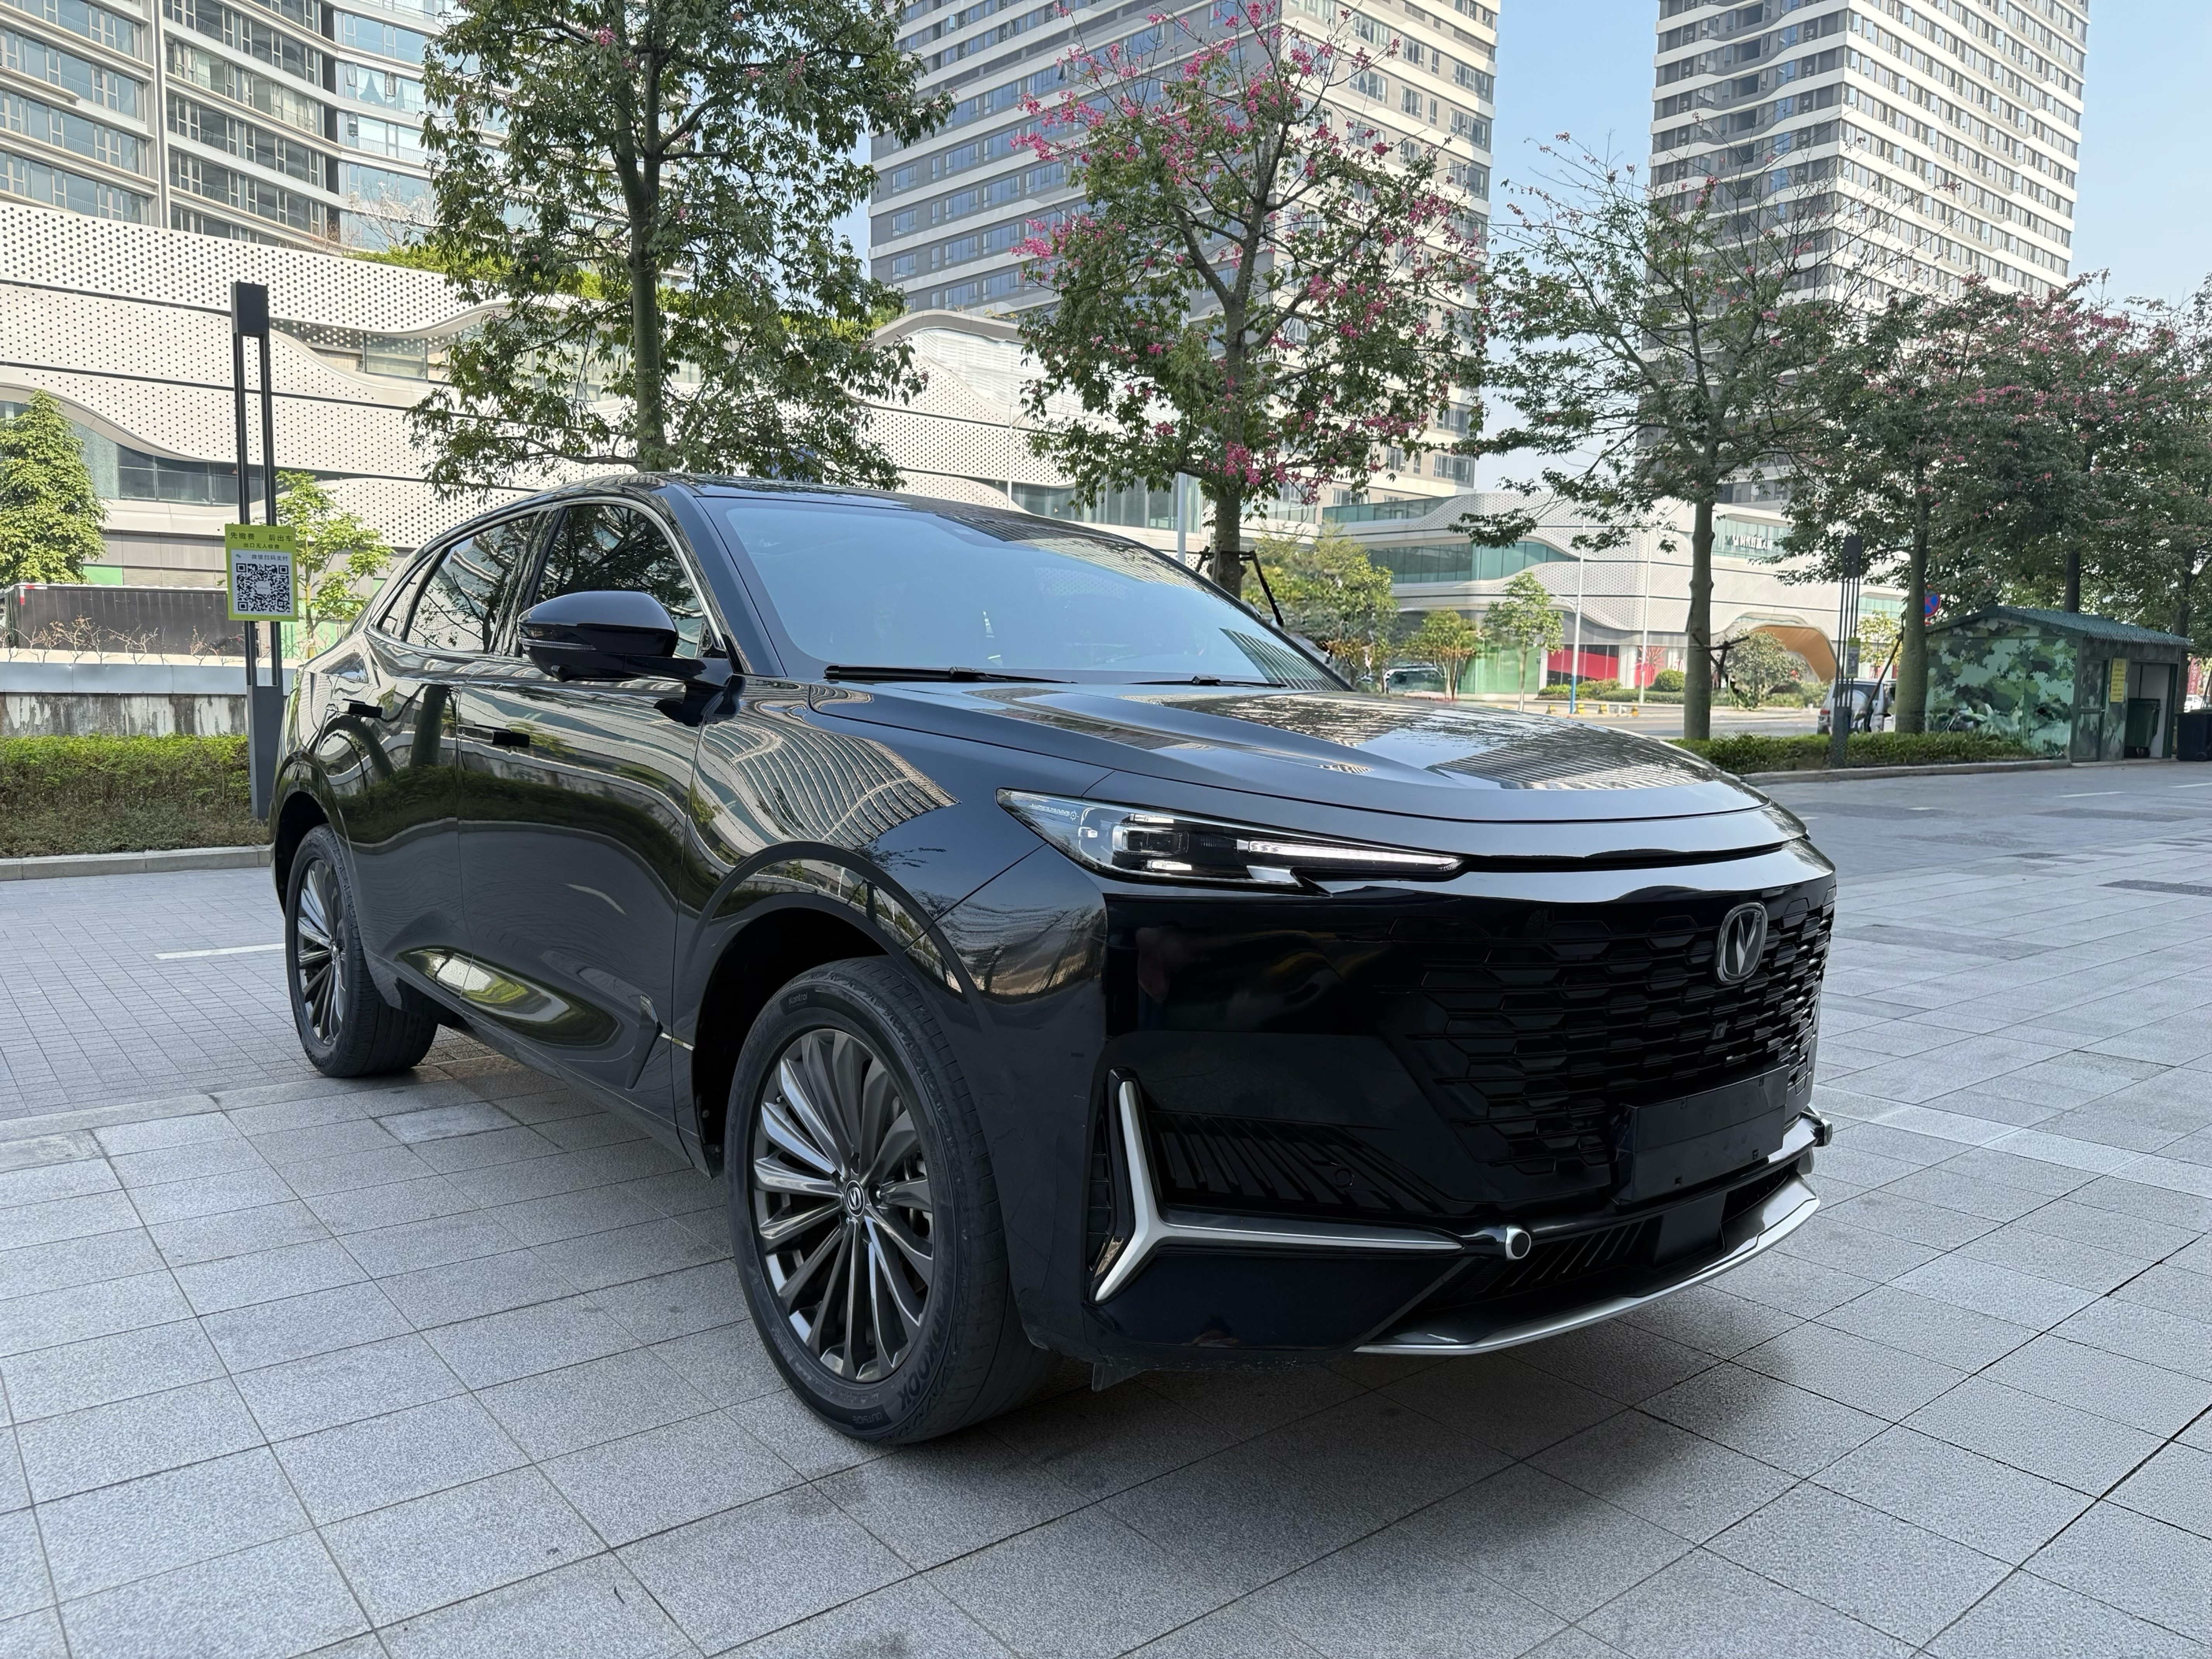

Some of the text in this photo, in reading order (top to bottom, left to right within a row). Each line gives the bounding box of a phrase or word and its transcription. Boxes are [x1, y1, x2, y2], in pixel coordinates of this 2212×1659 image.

[230, 532, 293, 543] 先缴费 后出车
[789, 992, 808, 1005] Kontrol
[852, 1412, 883, 1424] OUTSIDE
